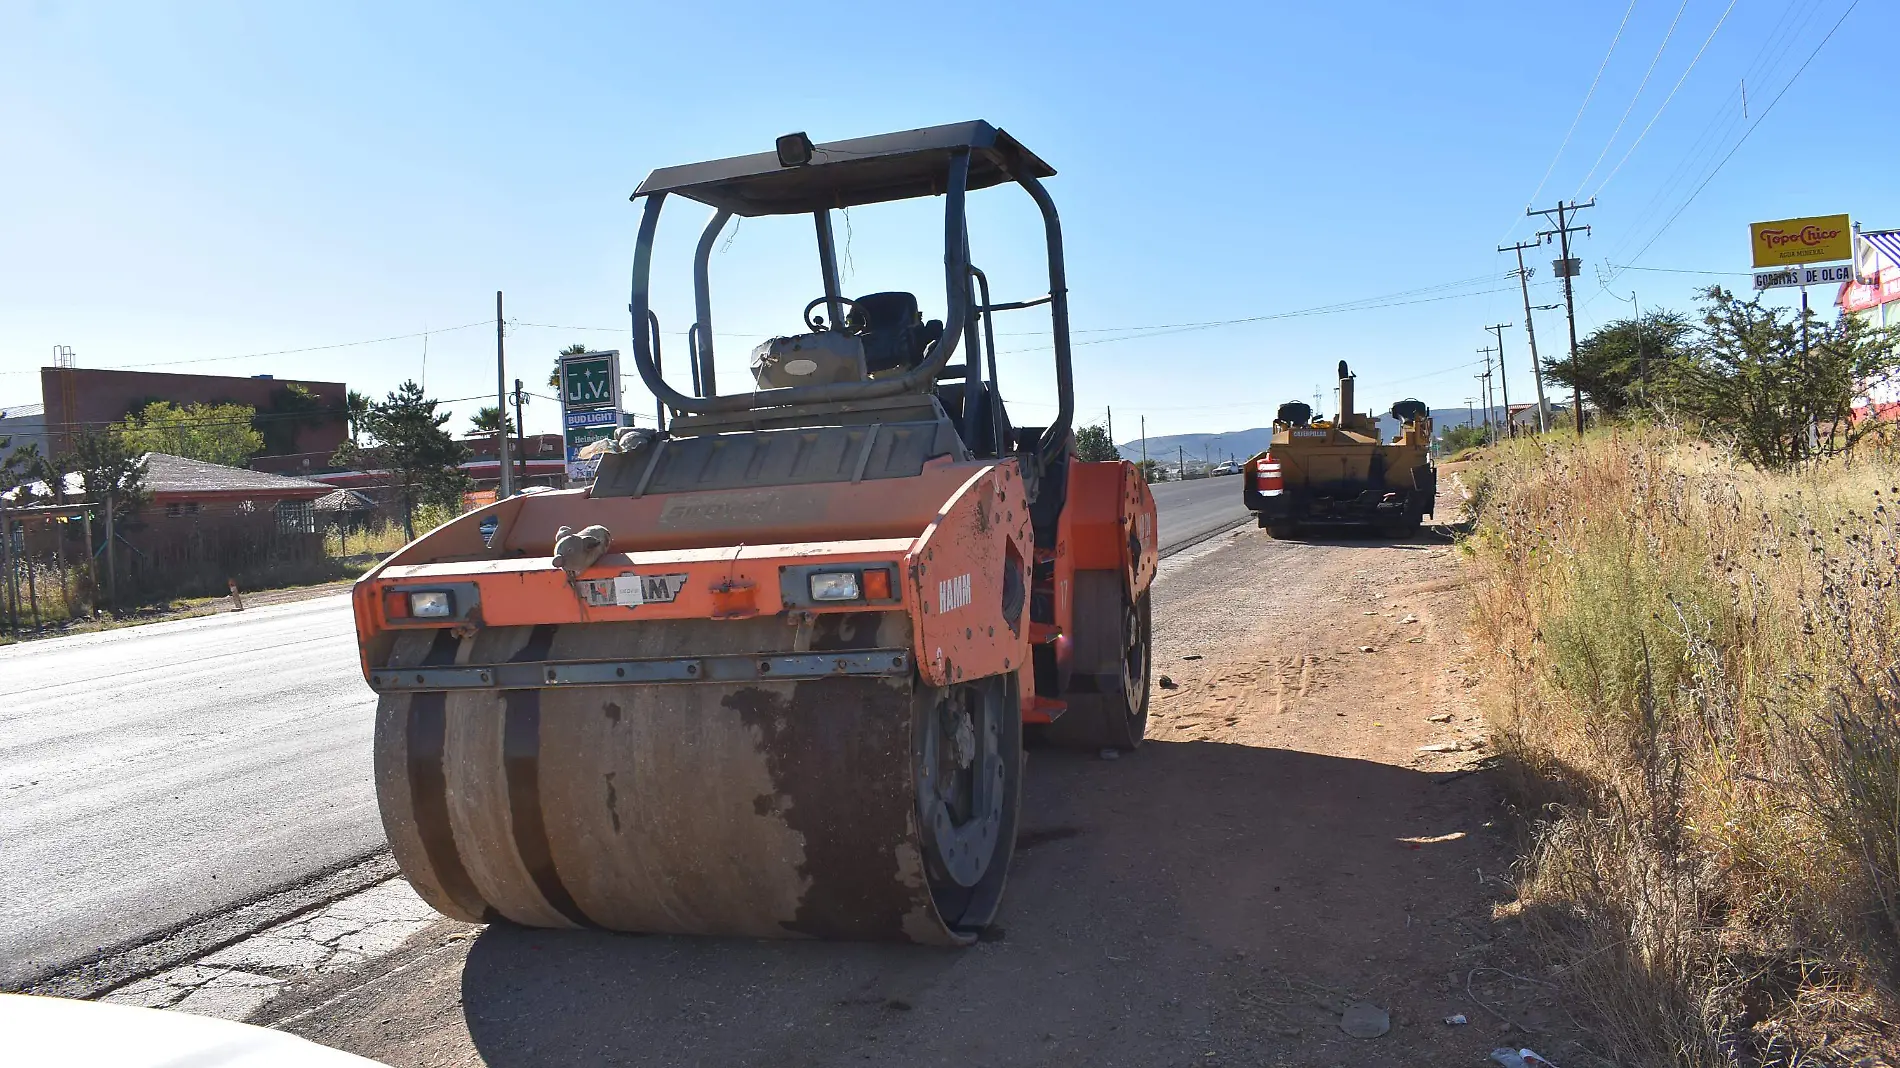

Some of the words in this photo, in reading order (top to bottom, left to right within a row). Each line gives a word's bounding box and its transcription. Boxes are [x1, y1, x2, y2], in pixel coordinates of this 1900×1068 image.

[1760, 229, 1800, 249] Topo
[1799, 225, 1841, 246] Chico
[1806, 269, 1818, 283] DE
[569, 380, 609, 401] J.V.
[568, 415, 586, 425] BUD
[587, 412, 613, 422] LIGHT
[939, 573, 972, 614] HAMM
